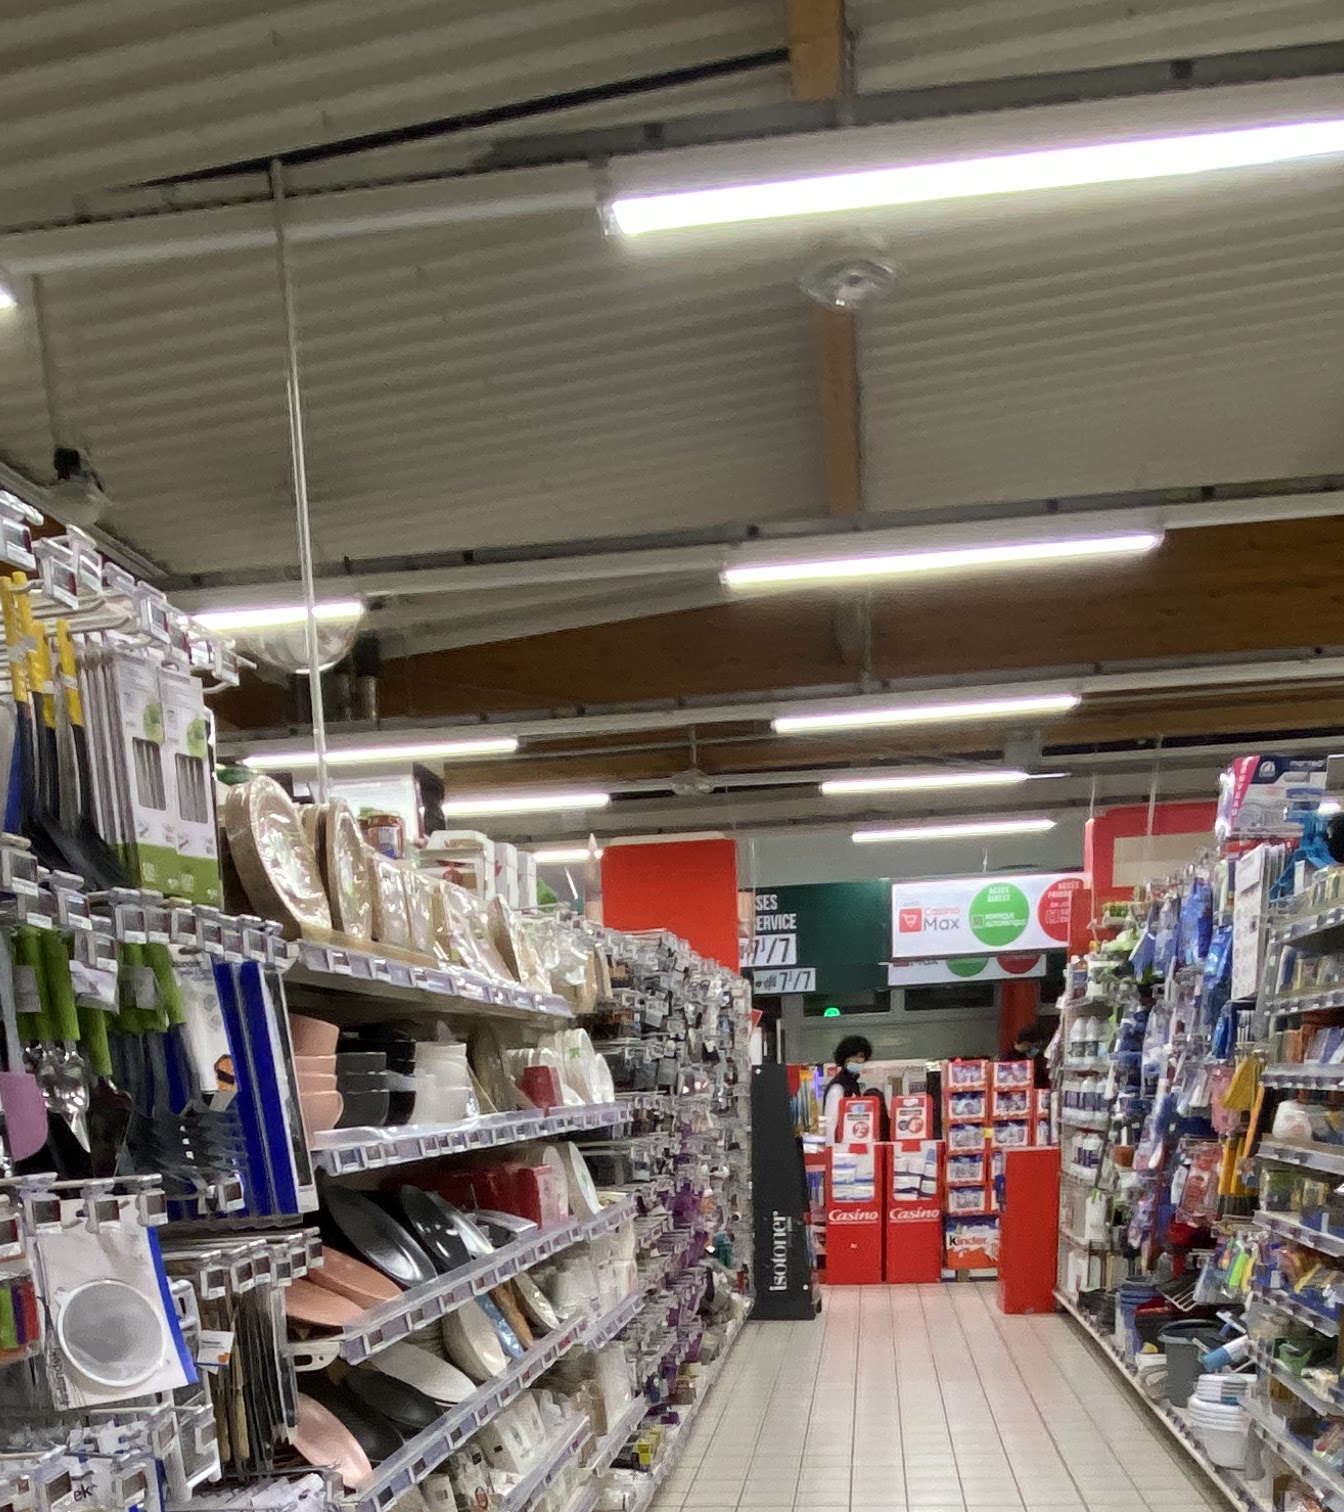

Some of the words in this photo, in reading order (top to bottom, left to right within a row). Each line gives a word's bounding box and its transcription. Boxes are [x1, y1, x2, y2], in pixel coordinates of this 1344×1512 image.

[756, 913, 797, 931] ERVICE
[923, 917, 960, 932] Max
[828, 1208, 879, 1222] Casino
[889, 1206, 940, 1220] Casino
[769, 1210, 788, 1292] Isotoner
